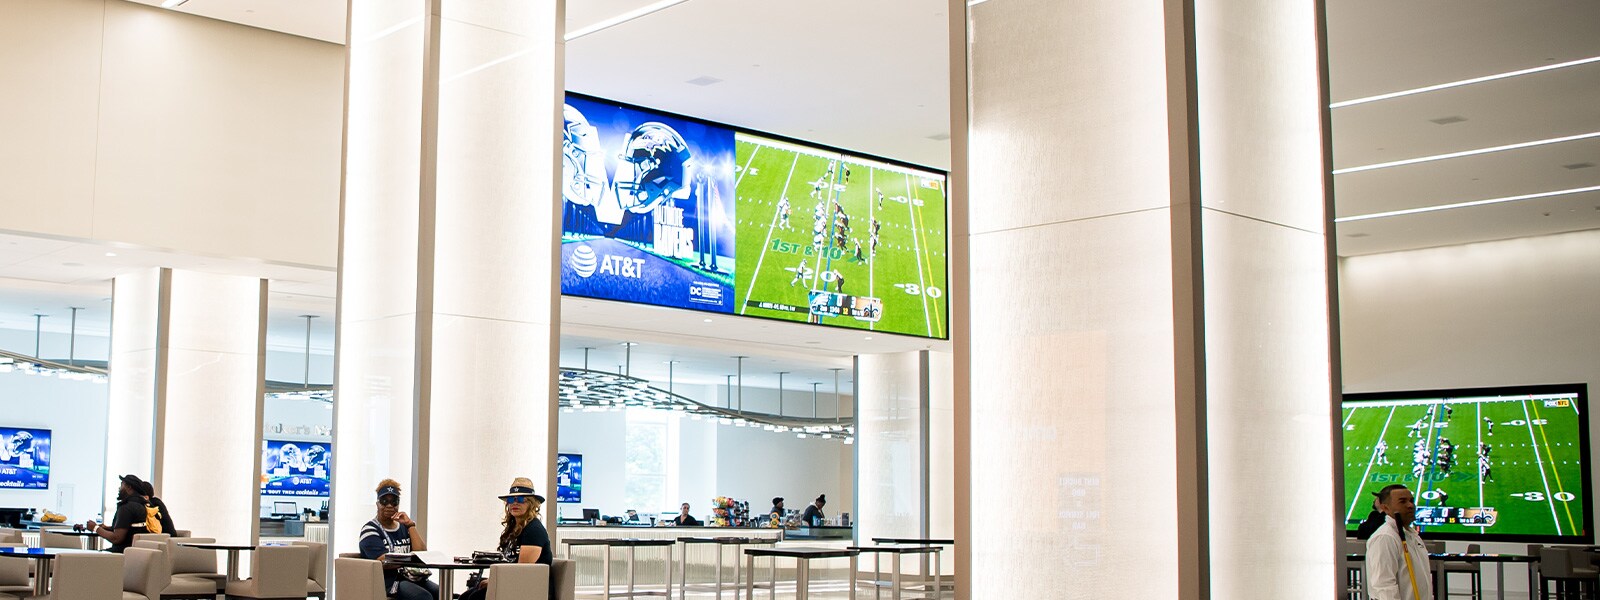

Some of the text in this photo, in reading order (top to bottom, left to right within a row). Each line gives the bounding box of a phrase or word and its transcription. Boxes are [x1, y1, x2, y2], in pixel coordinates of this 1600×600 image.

[771, 238, 842, 260] 1ST & 10
[600, 254, 645, 279] AT&T
[690, 286, 701, 296] DC
[1370, 471, 1399, 482] 1ST
